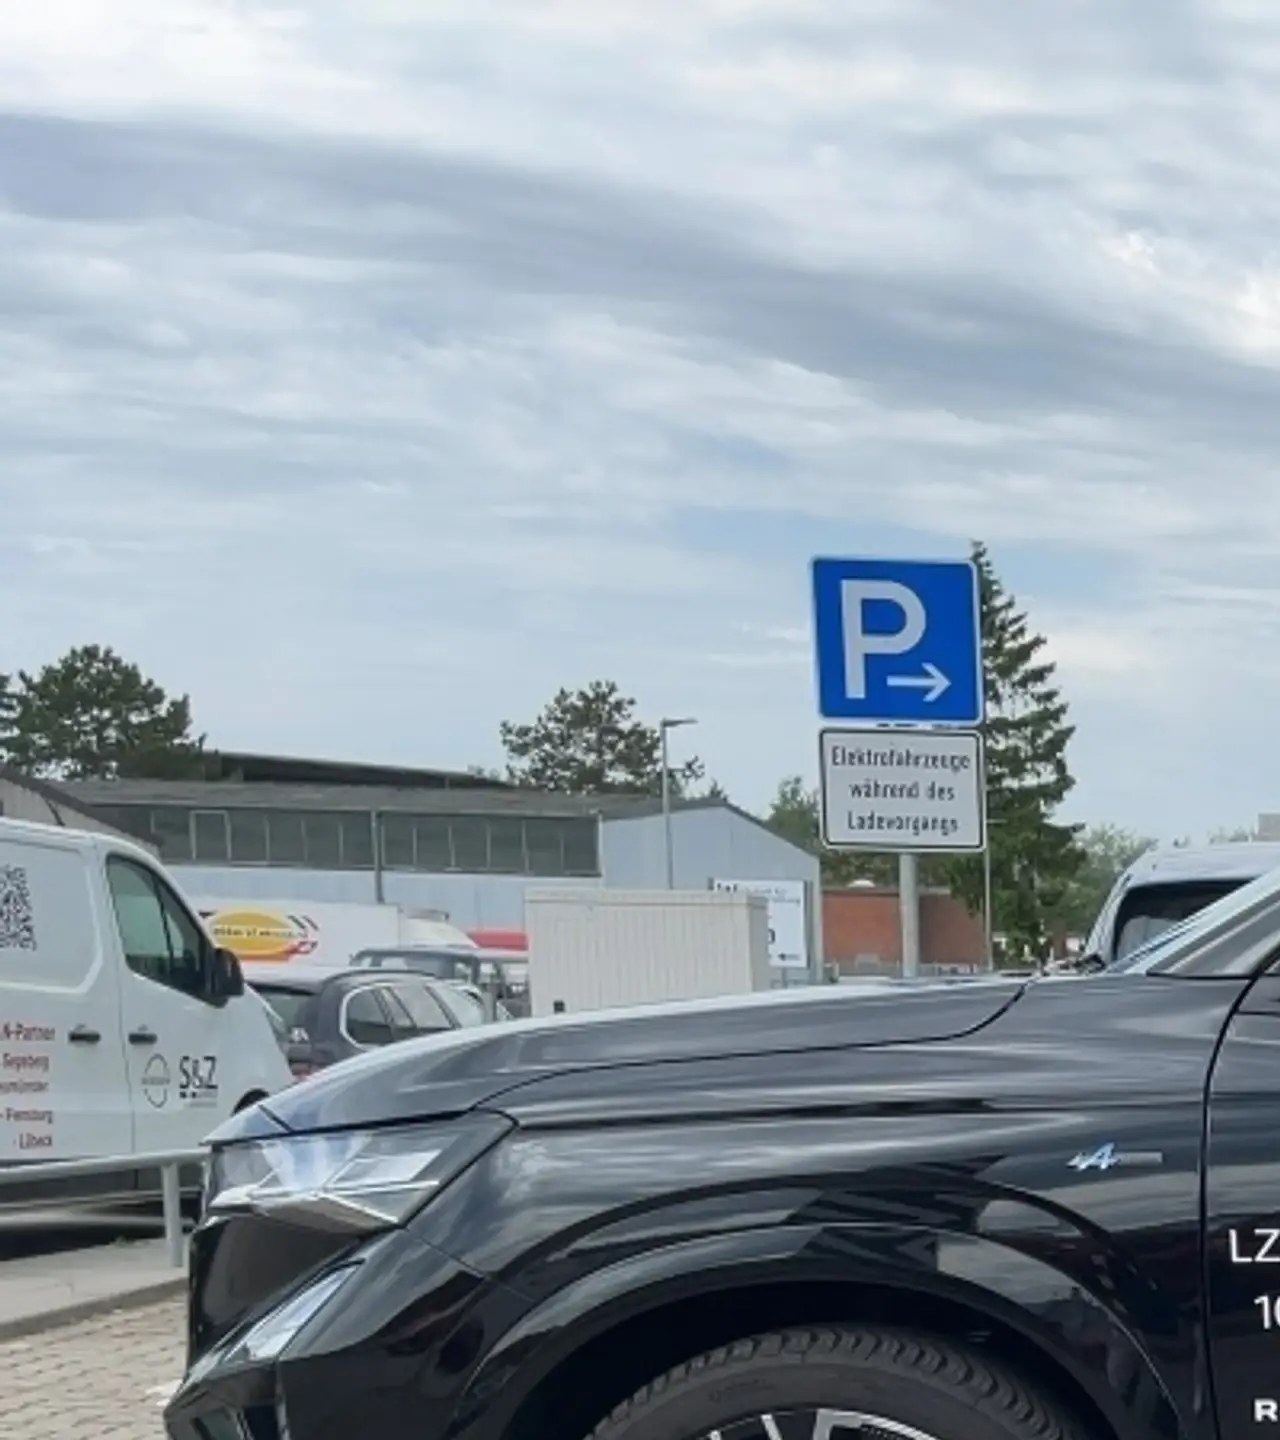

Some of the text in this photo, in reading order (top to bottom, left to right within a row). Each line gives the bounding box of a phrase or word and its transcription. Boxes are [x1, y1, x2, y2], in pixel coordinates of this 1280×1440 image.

[840, 579, 926, 699] P
[831, 746, 971, 775] Elektrofahrzeuge
[849, 778, 956, 801] während des
[847, 811, 959, 837] Ladevorgangs
[179, 1055, 219, 1090] S&Z
